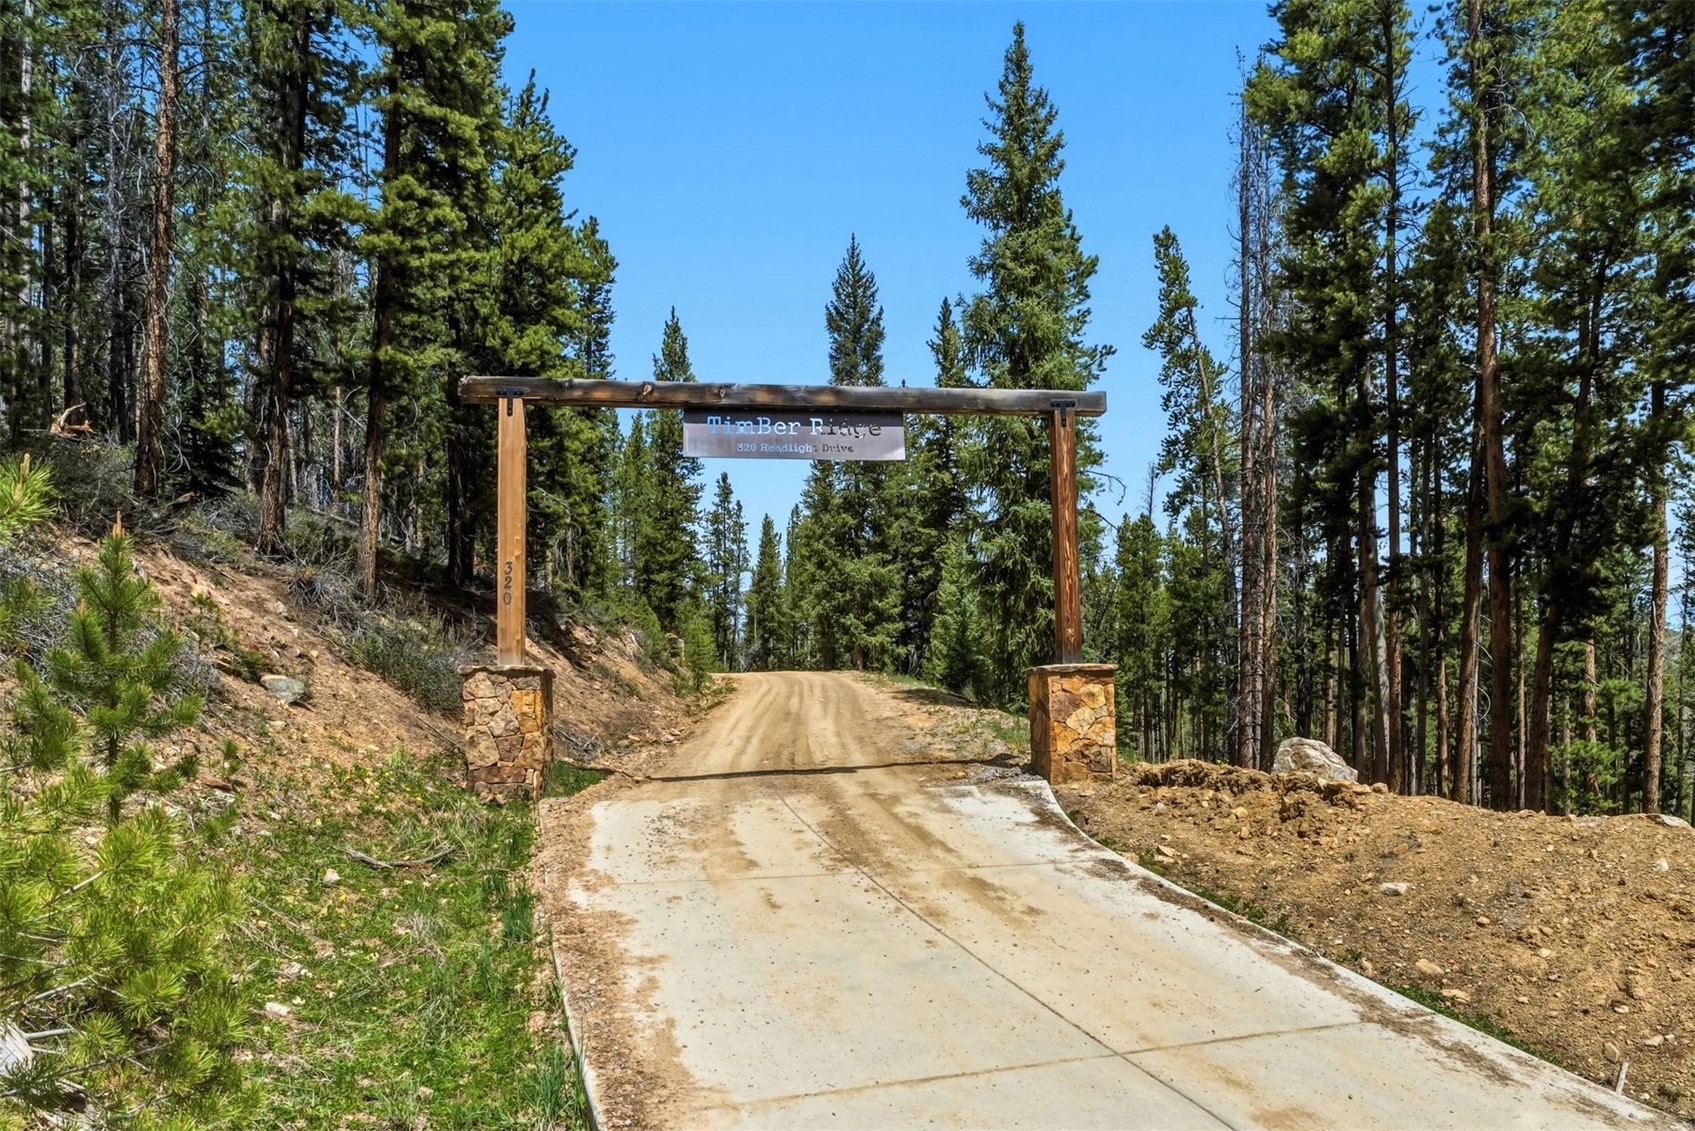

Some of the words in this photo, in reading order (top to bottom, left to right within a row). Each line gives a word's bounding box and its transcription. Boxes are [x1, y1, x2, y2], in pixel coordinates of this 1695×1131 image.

[706, 416, 801, 435] TimBer
[810, 417, 882, 439] Ridge
[737, 443, 757, 453] 320
[822, 443, 854, 453] Drive
[503, 561, 513, 605] 320
